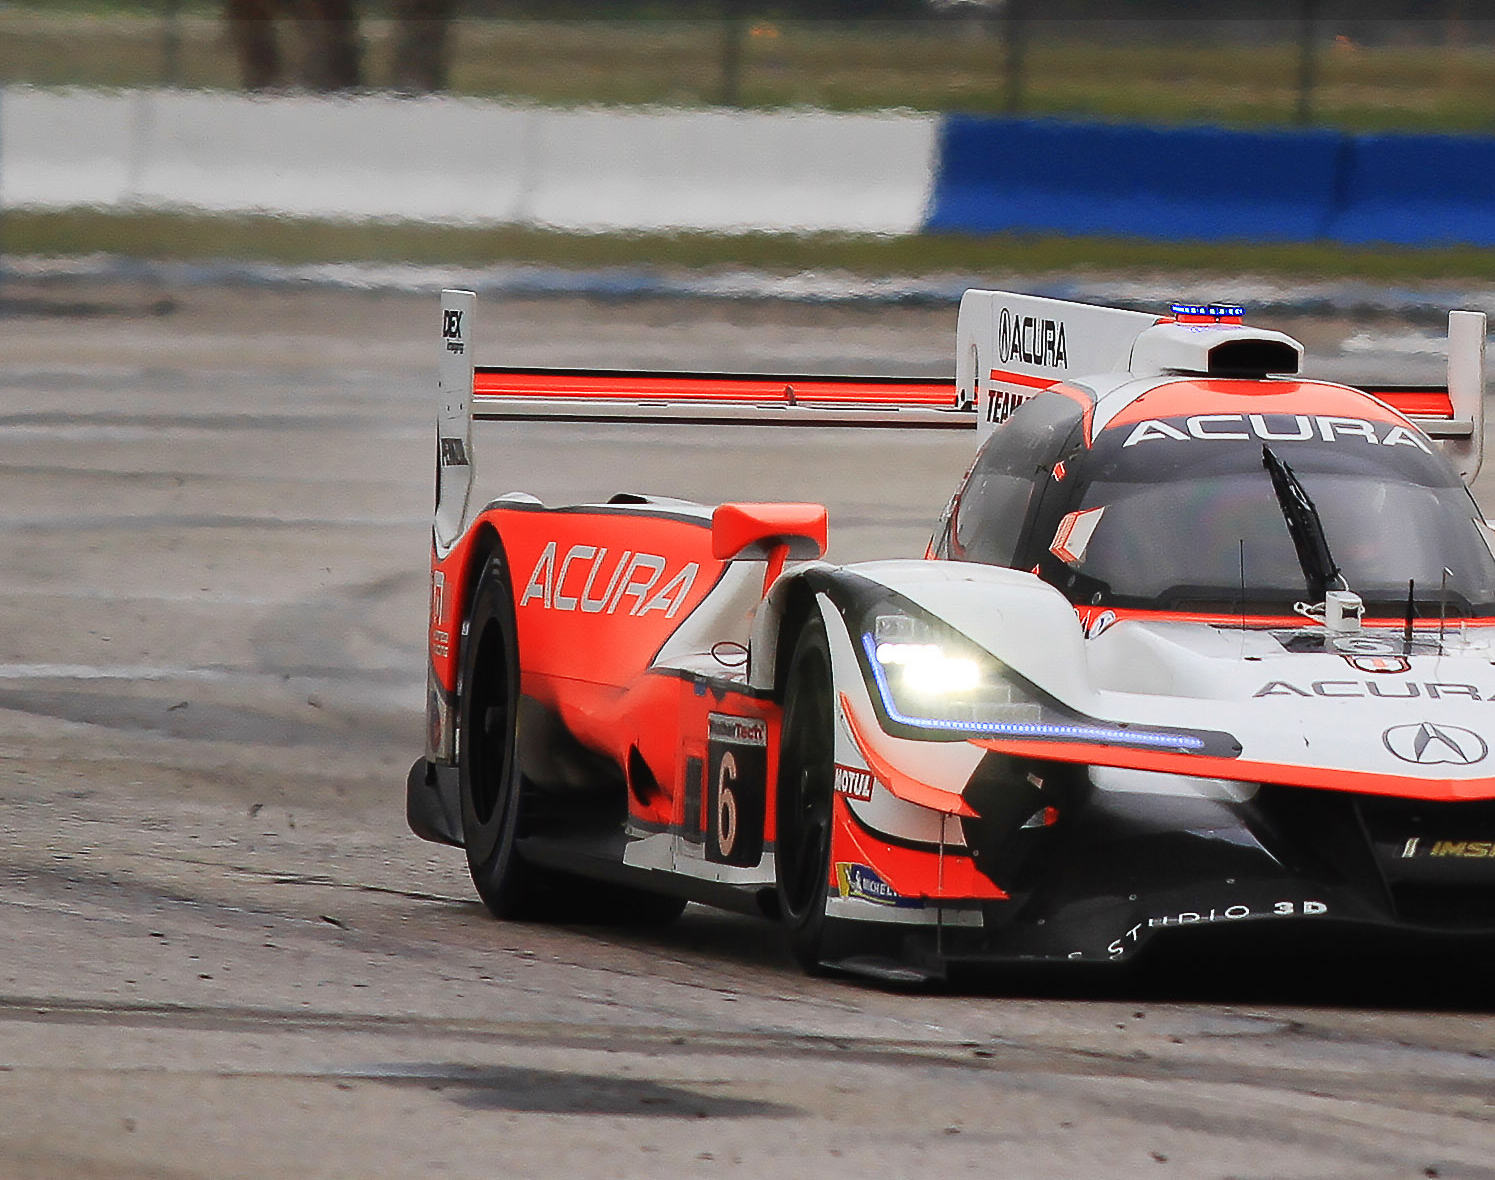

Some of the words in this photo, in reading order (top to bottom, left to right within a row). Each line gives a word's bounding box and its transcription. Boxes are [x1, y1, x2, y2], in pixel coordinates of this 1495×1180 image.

[1010, 314, 1068, 370] ACURA
[1122, 414, 1433, 455] ACURA
[520, 541, 701, 619] ACURA
[717, 750, 737, 858] 6
[834, 768, 872, 799] MOTUL
[1273, 901, 1328, 916] 3D
